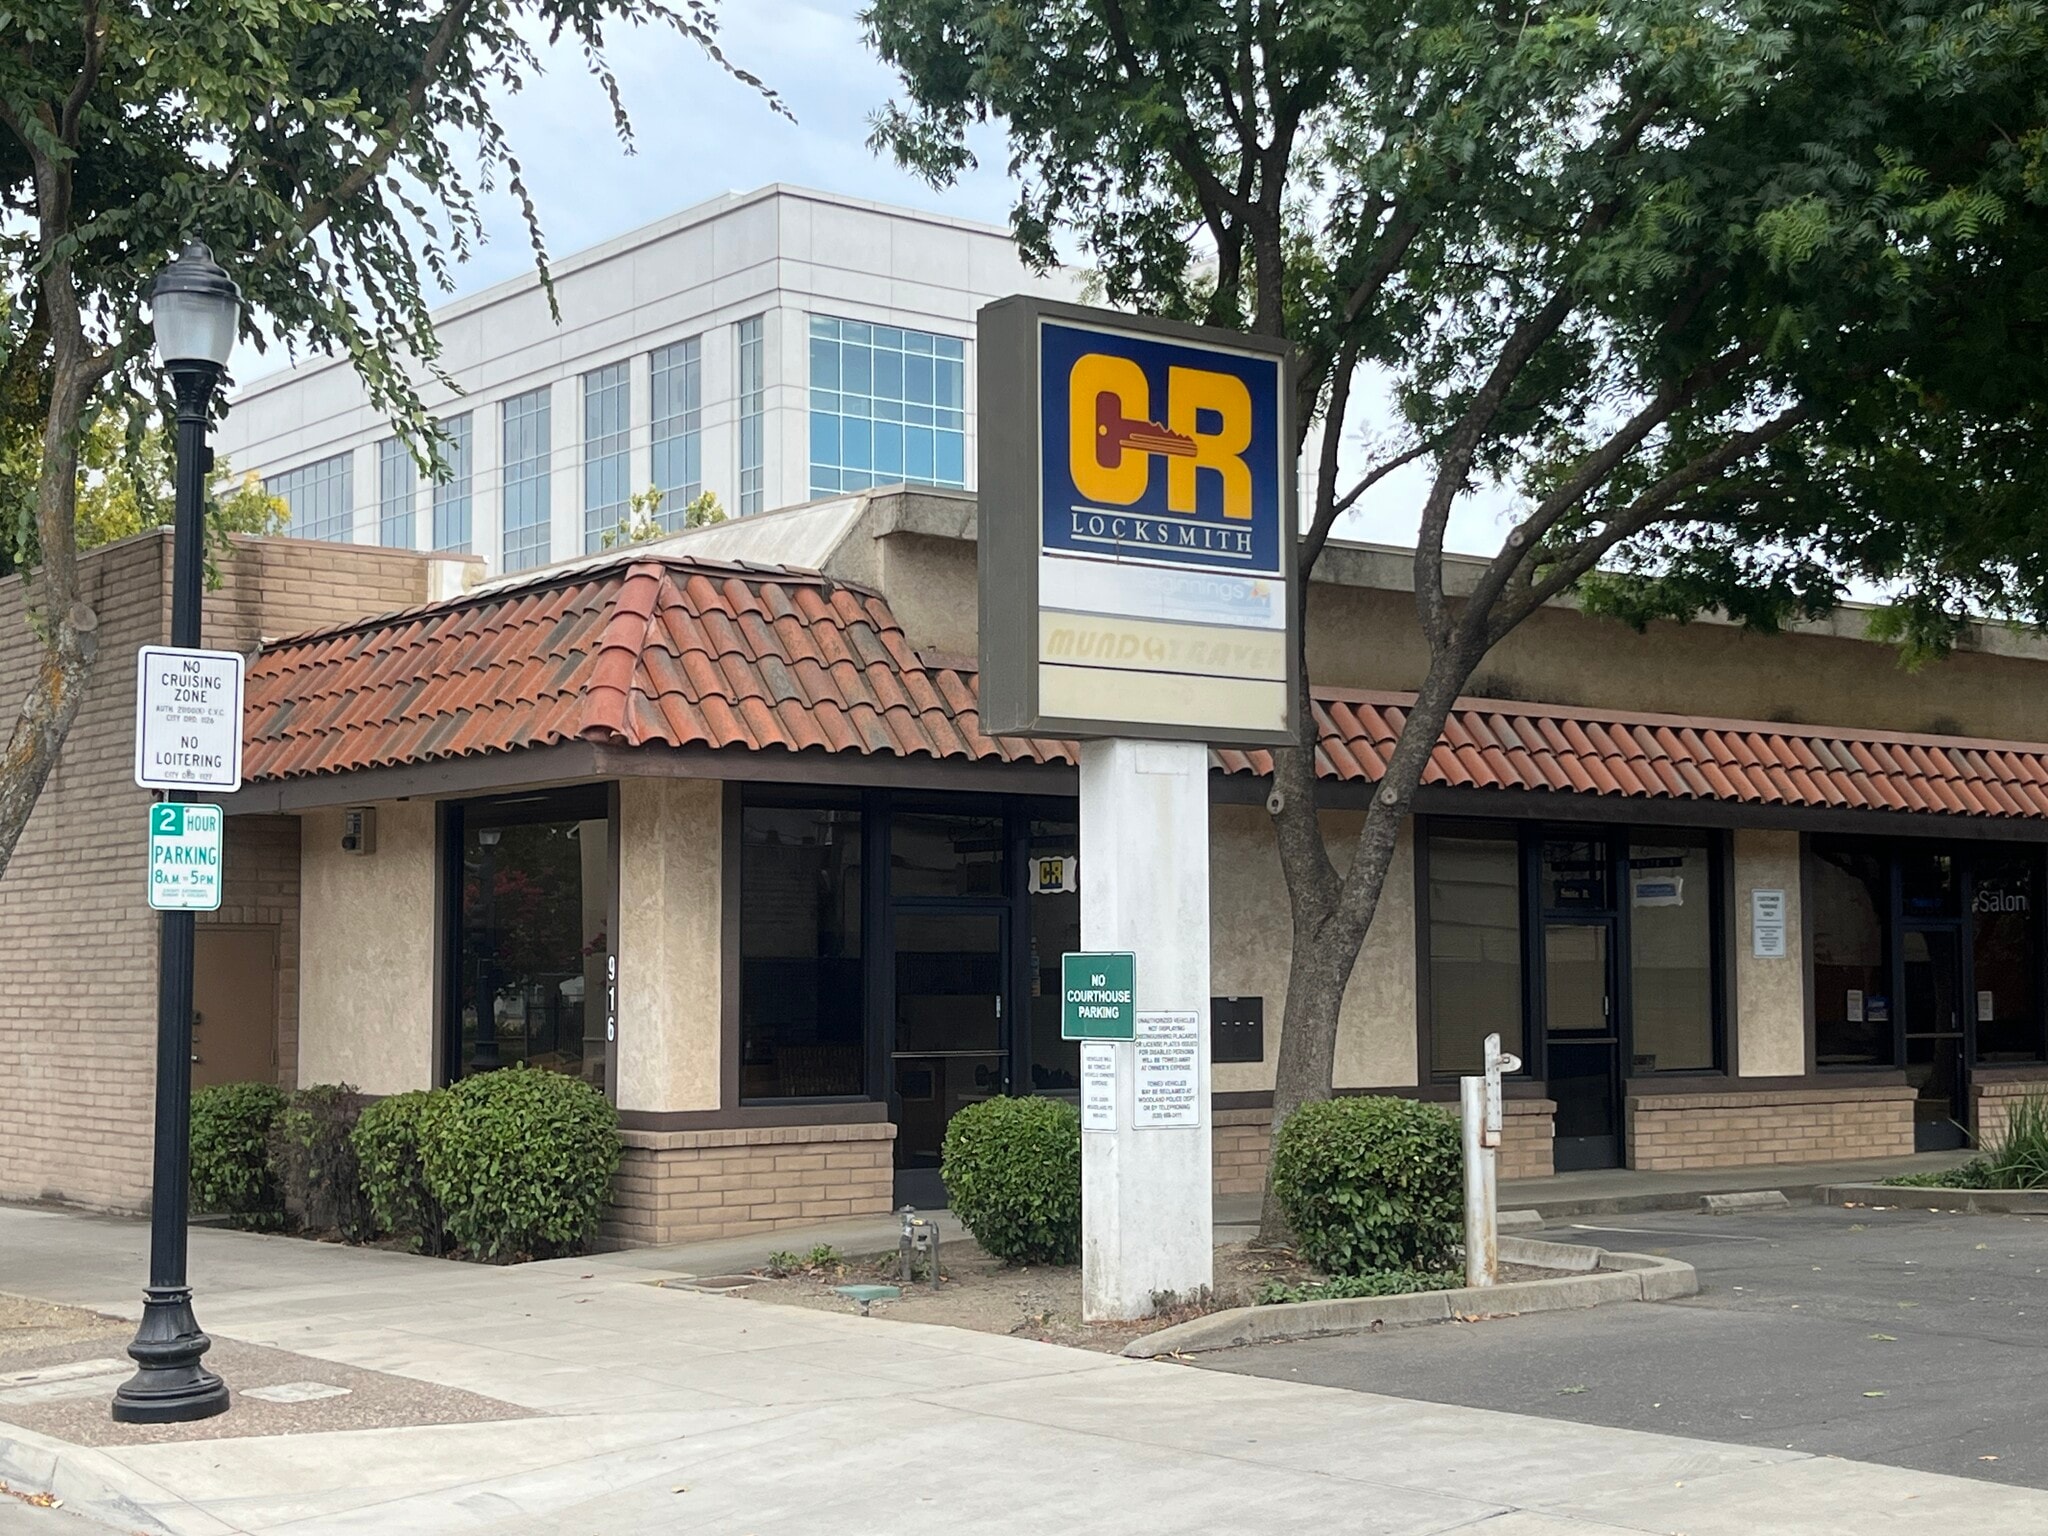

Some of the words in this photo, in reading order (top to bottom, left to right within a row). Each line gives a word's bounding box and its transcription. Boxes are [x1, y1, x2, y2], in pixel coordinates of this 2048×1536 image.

[1069, 352, 1253, 520] CR
[1070, 512, 1252, 552] LOCKSMITH
[183, 661, 200, 674] NO
[161, 674, 221, 690] CRUISING
[174, 688, 207, 703] ZONE
[181, 736, 198, 749] NO
[156, 752, 222, 768] LOITERING
[159, 809, 176, 832] 2
[187, 815, 216, 832] HOUR
[155, 845, 216, 866] PARKING
[1041, 862, 1062, 885] CR
[1978, 888, 2026, 912] Salon
[1091, 974, 1106, 987] NO
[1067, 990, 1131, 1003] COURTHOUSE
[1078, 1006, 1119, 1019] PARKING
